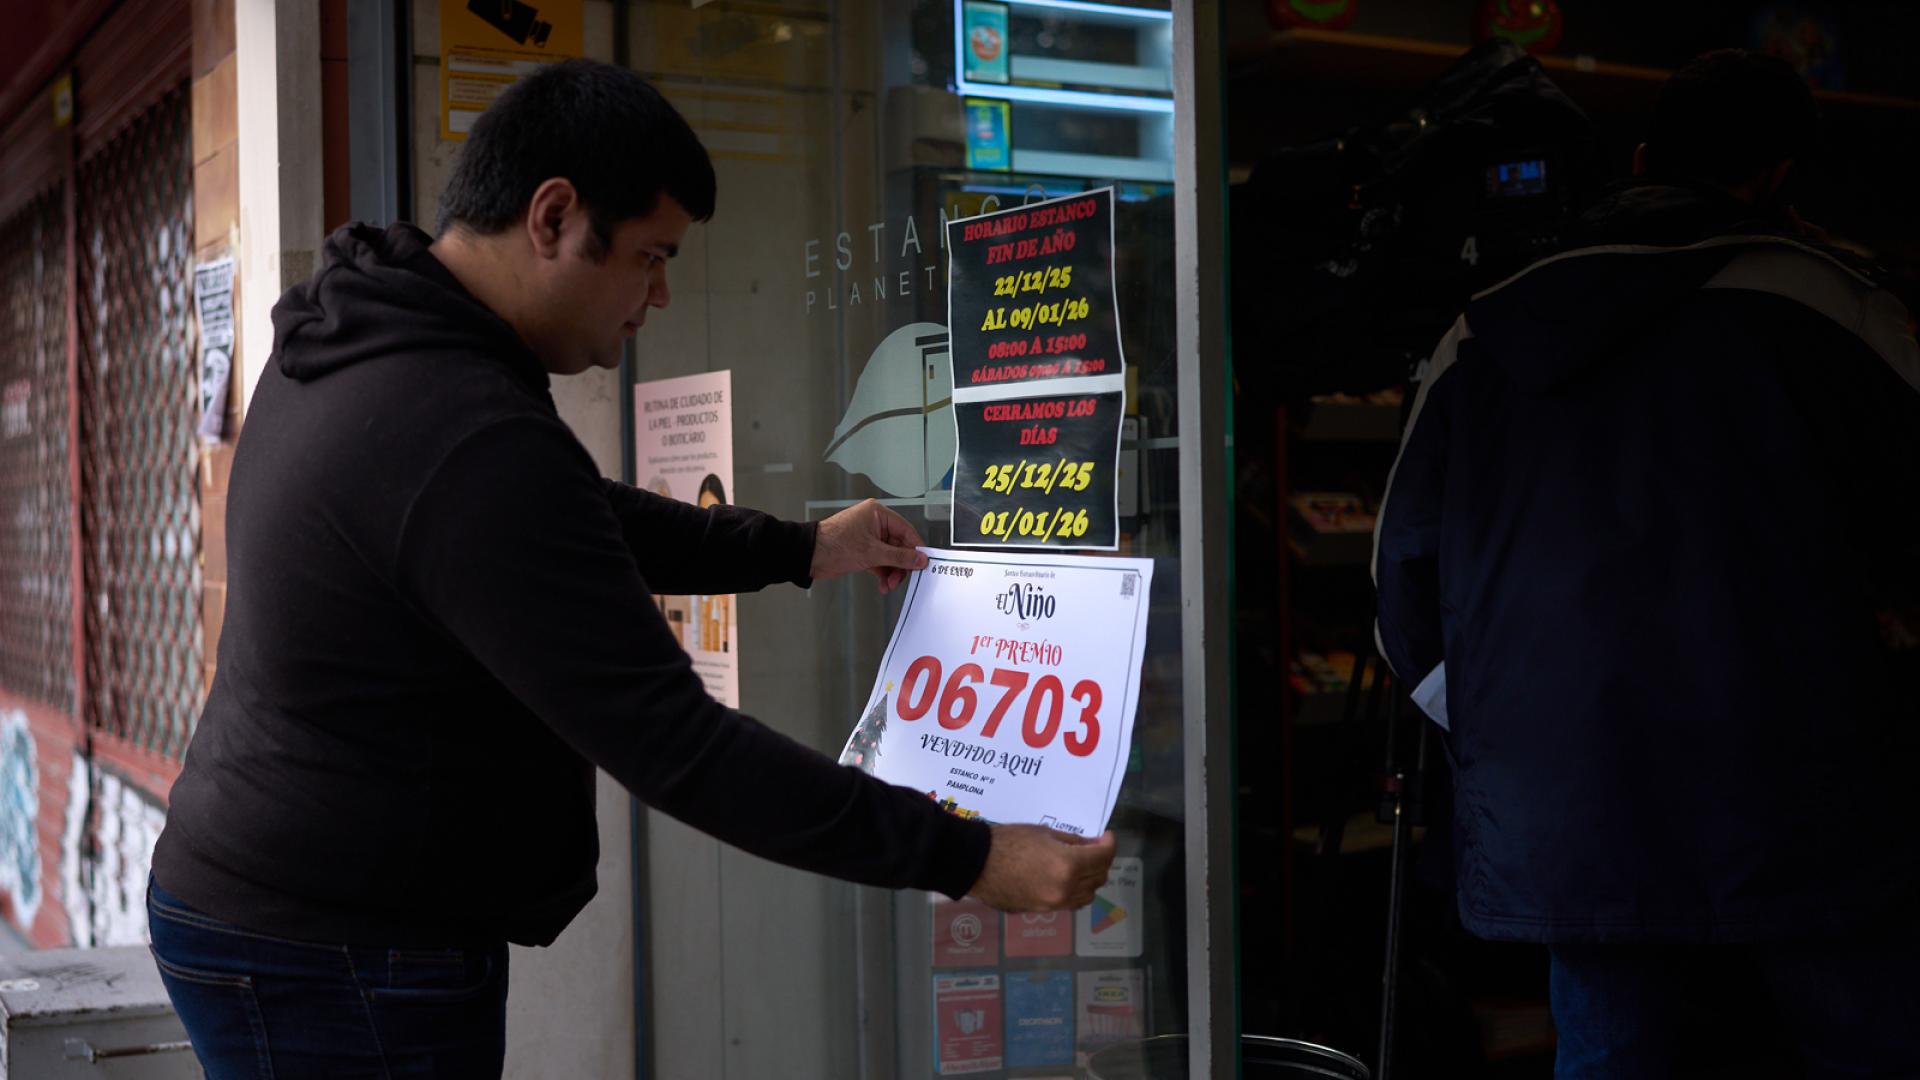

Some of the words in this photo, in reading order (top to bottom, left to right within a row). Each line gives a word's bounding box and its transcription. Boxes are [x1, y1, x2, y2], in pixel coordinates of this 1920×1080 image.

[964, 213, 1027, 241] HORARIO
[1030, 200, 1097, 228] ESTANCO
[986, 244, 1012, 264] FIN
[1016, 240, 1038, 259] DE
[1039, 228, 1076, 254] AÑO
[1459, 235, 1479, 266] 4
[994, 265, 1072, 298] 22/12/25
[981, 307, 1007, 331] AL
[1010, 297, 1089, 330] 09/01/26
[988, 341, 1027, 360] 08:00
[1028, 336, 1042, 355] A
[1046, 332, 1086, 354] 15:00
[972, 364, 1028, 383] SÁBADOS
[1061, 360, 1072, 374] A
[670, 396, 679, 409] DE
[680, 392, 712, 408] CUIDADO
[714, 390, 724, 403] DE
[983, 401, 1066, 421] CERRAMOS
[1067, 399, 1097, 416] LOS
[648, 418, 658, 431] LA
[658, 416, 672, 429] PIEL
[677, 411, 719, 426] PRODUCTOS
[1020, 425, 1058, 445] DÍAS
[982, 458, 1095, 495] 25/12/25
[979, 506, 1089, 543] 01/01/26
[931, 565, 937, 573] 6
[937, 565, 949, 575] DE
[949, 566, 974, 578] ENERO
[996, 593, 1008, 610] El
[1004, 583, 1056, 620] Niño
[970, 635, 993, 656] 1er
[995, 637, 1062, 666] PREMIO
[896, 655, 1103, 757] 06703
[920, 733, 997, 765] VENDIDO
[993, 752, 1044, 778] AQUÍ
[946, 780, 984, 795] PAMPLONA
[950, 767, 979, 780] ESTANCO
